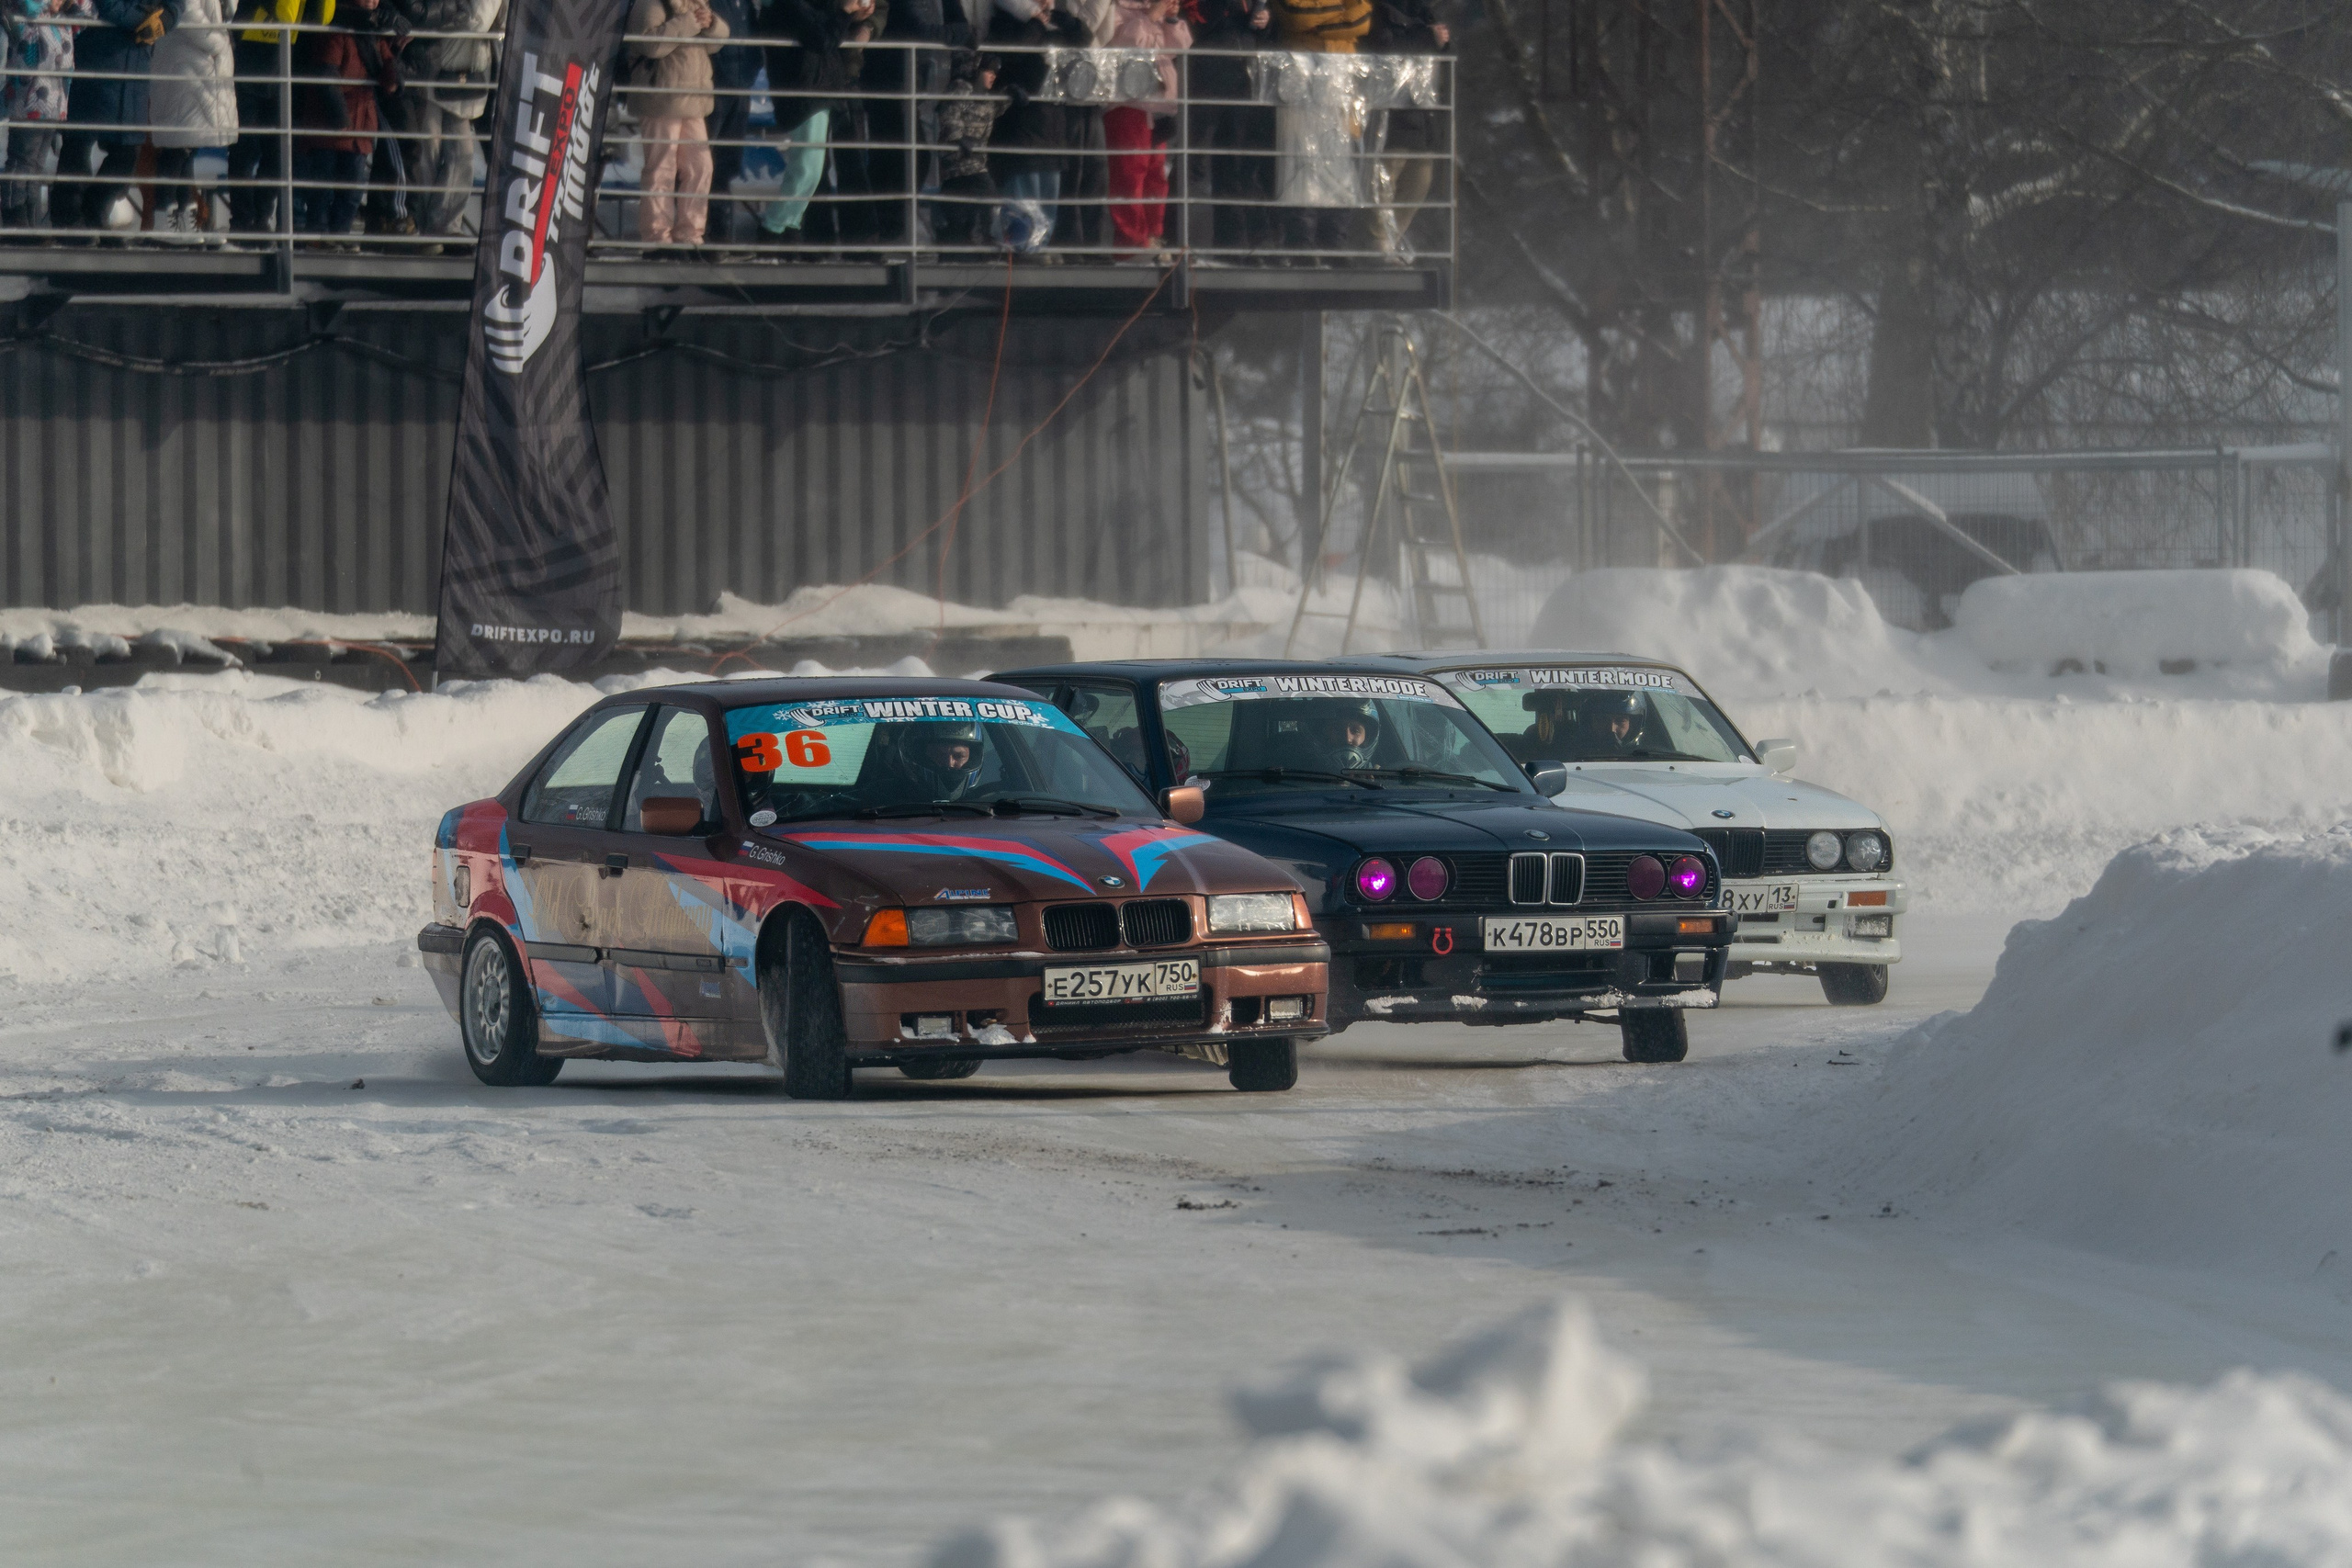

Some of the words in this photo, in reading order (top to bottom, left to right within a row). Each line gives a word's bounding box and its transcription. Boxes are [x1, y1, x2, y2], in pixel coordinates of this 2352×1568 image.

[549, 86, 576, 176] EXPO
[500, 51, 564, 284] DRIFT
[470, 624, 595, 644] DRIFTEXPO.RU
[1216, 679, 1263, 690] DRIFT
[1474, 671, 1518, 682] DRIFT
[1529, 670, 1615, 685] WINTER
[1618, 671, 1675, 689] MODE
[1273, 677, 1369, 693] WINTER
[1369, 678, 1430, 697] MODE
[810, 705, 861, 716] DRIFT
[863, 700, 974, 719] WINTER
[976, 702, 1033, 722] CUP
[737, 729, 831, 773] 36
[1771, 886, 1792, 903] 13
[1492, 921, 1583, 947] К478ВР
[1586, 919, 1619, 939] 550
[1594, 939, 1610, 947] RUS
[1054, 969, 1151, 998] Е257УК
[1157, 962, 1193, 985] 750
[1166, 983, 1184, 992] RUS
